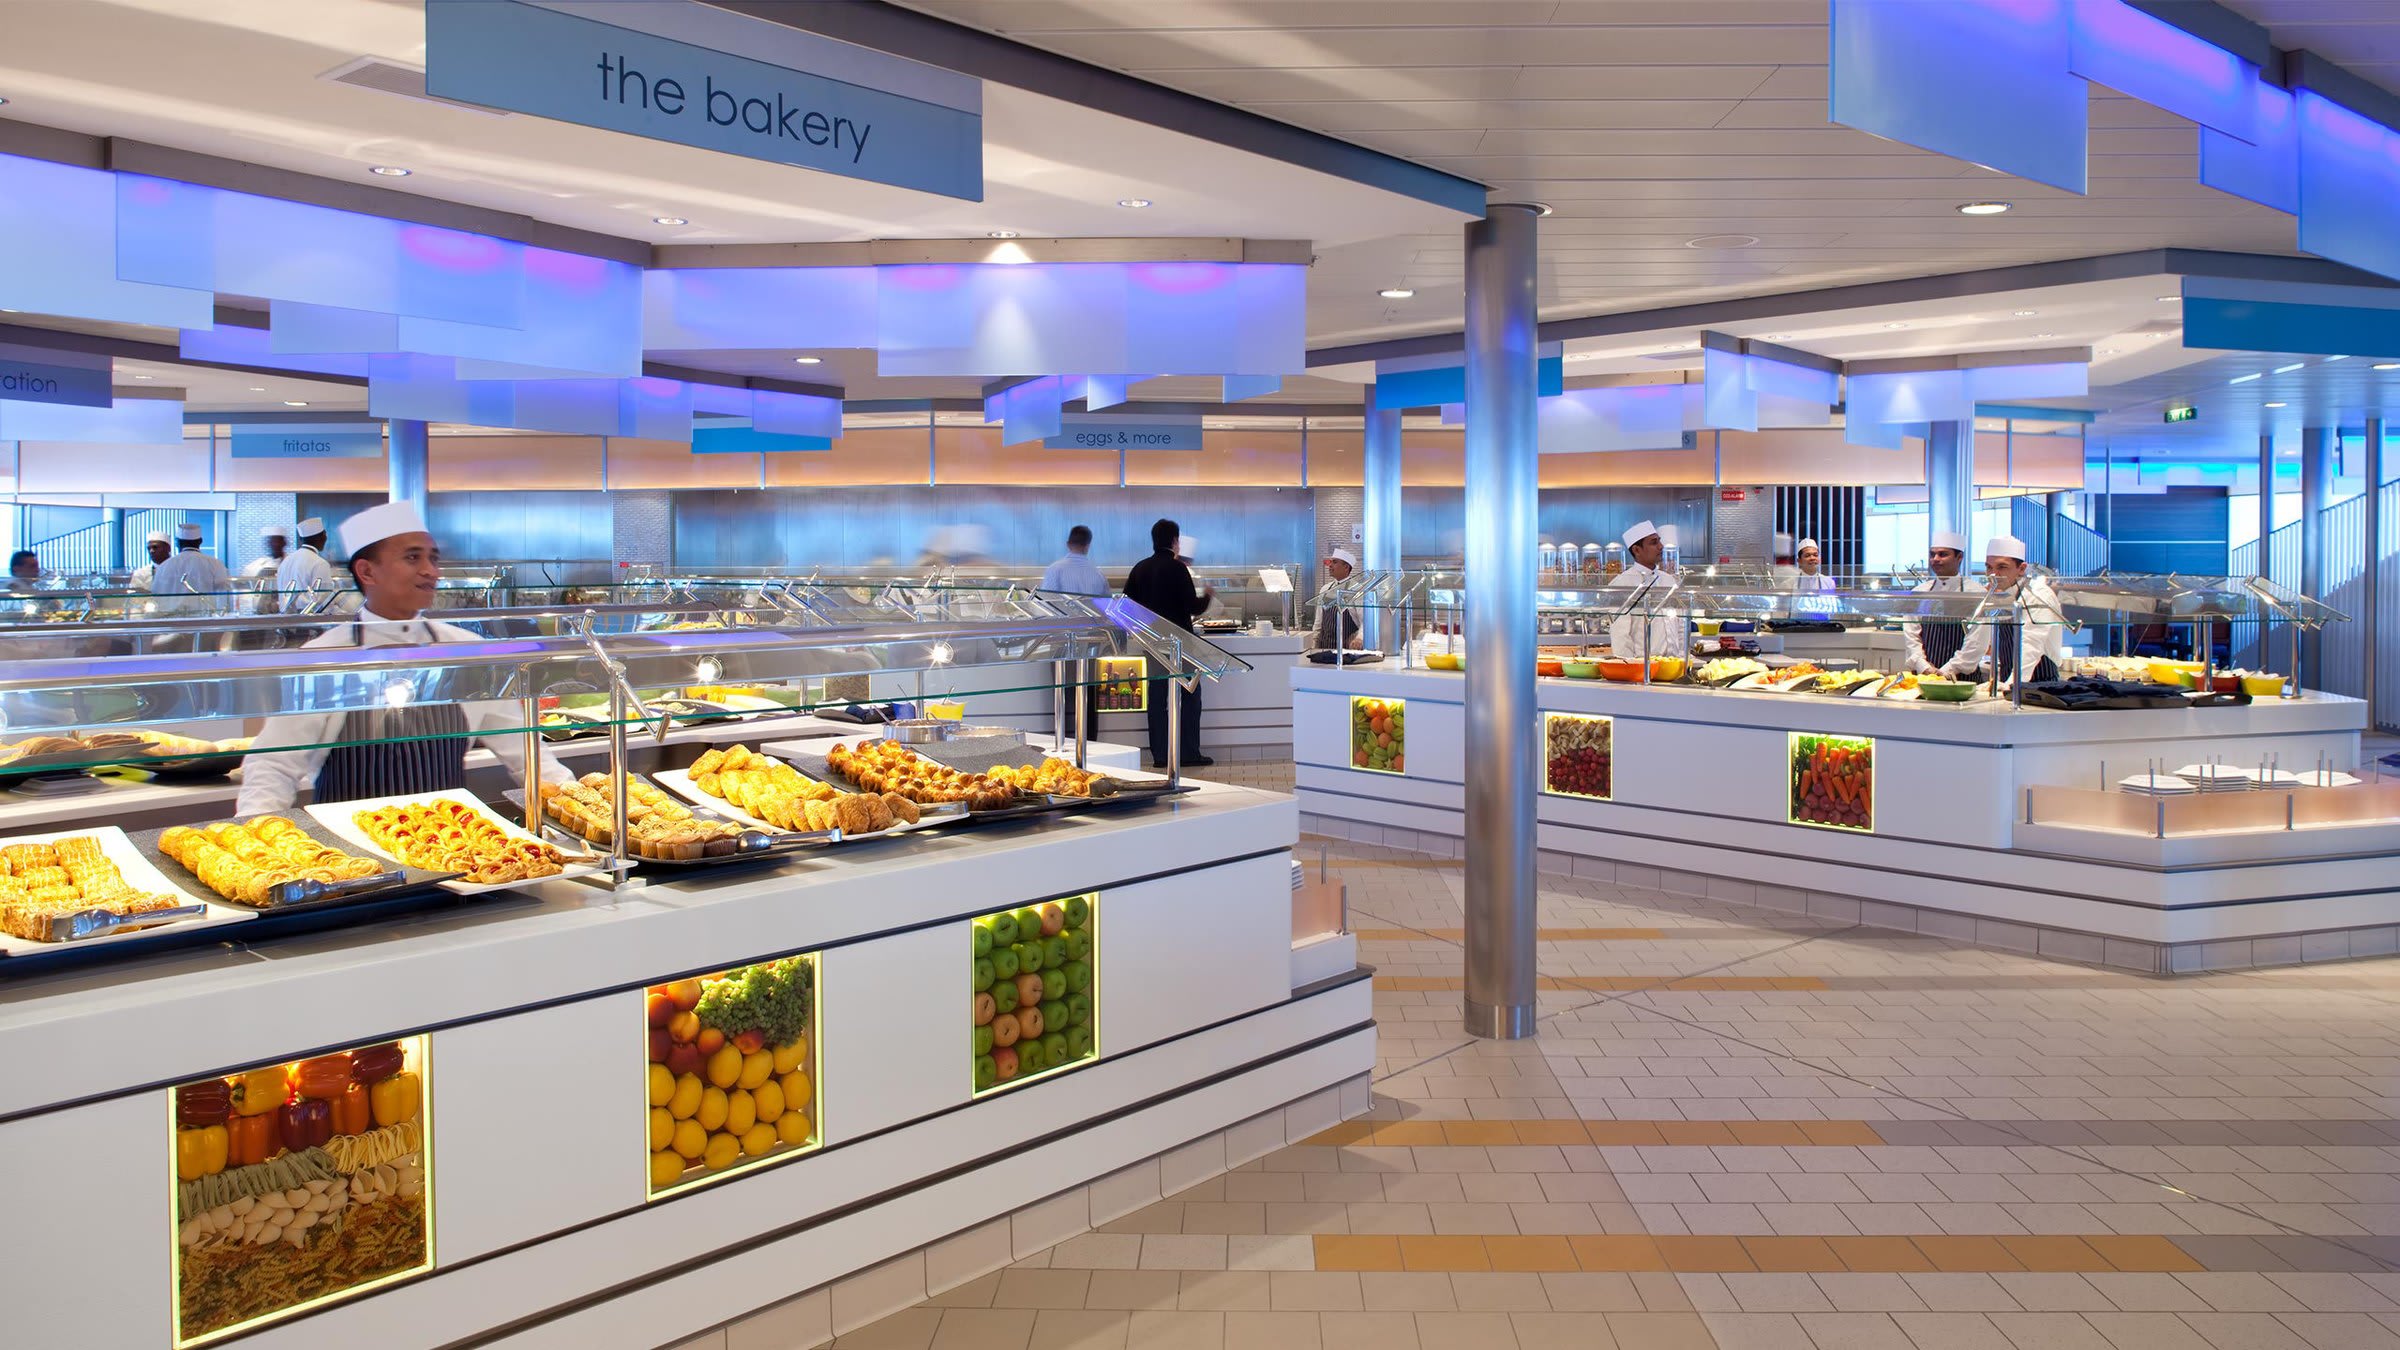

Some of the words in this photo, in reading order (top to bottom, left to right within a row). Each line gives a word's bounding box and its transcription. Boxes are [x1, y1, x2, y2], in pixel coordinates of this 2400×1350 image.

[597, 52, 686, 115] the
[706, 76, 872, 164] bakery
[0, 372, 58, 393] ation
[283, 439, 331, 453] fritatas
[1075, 432, 1113, 447] eggs
[1117, 431, 1129, 444] &
[1133, 433, 1172, 445] more
